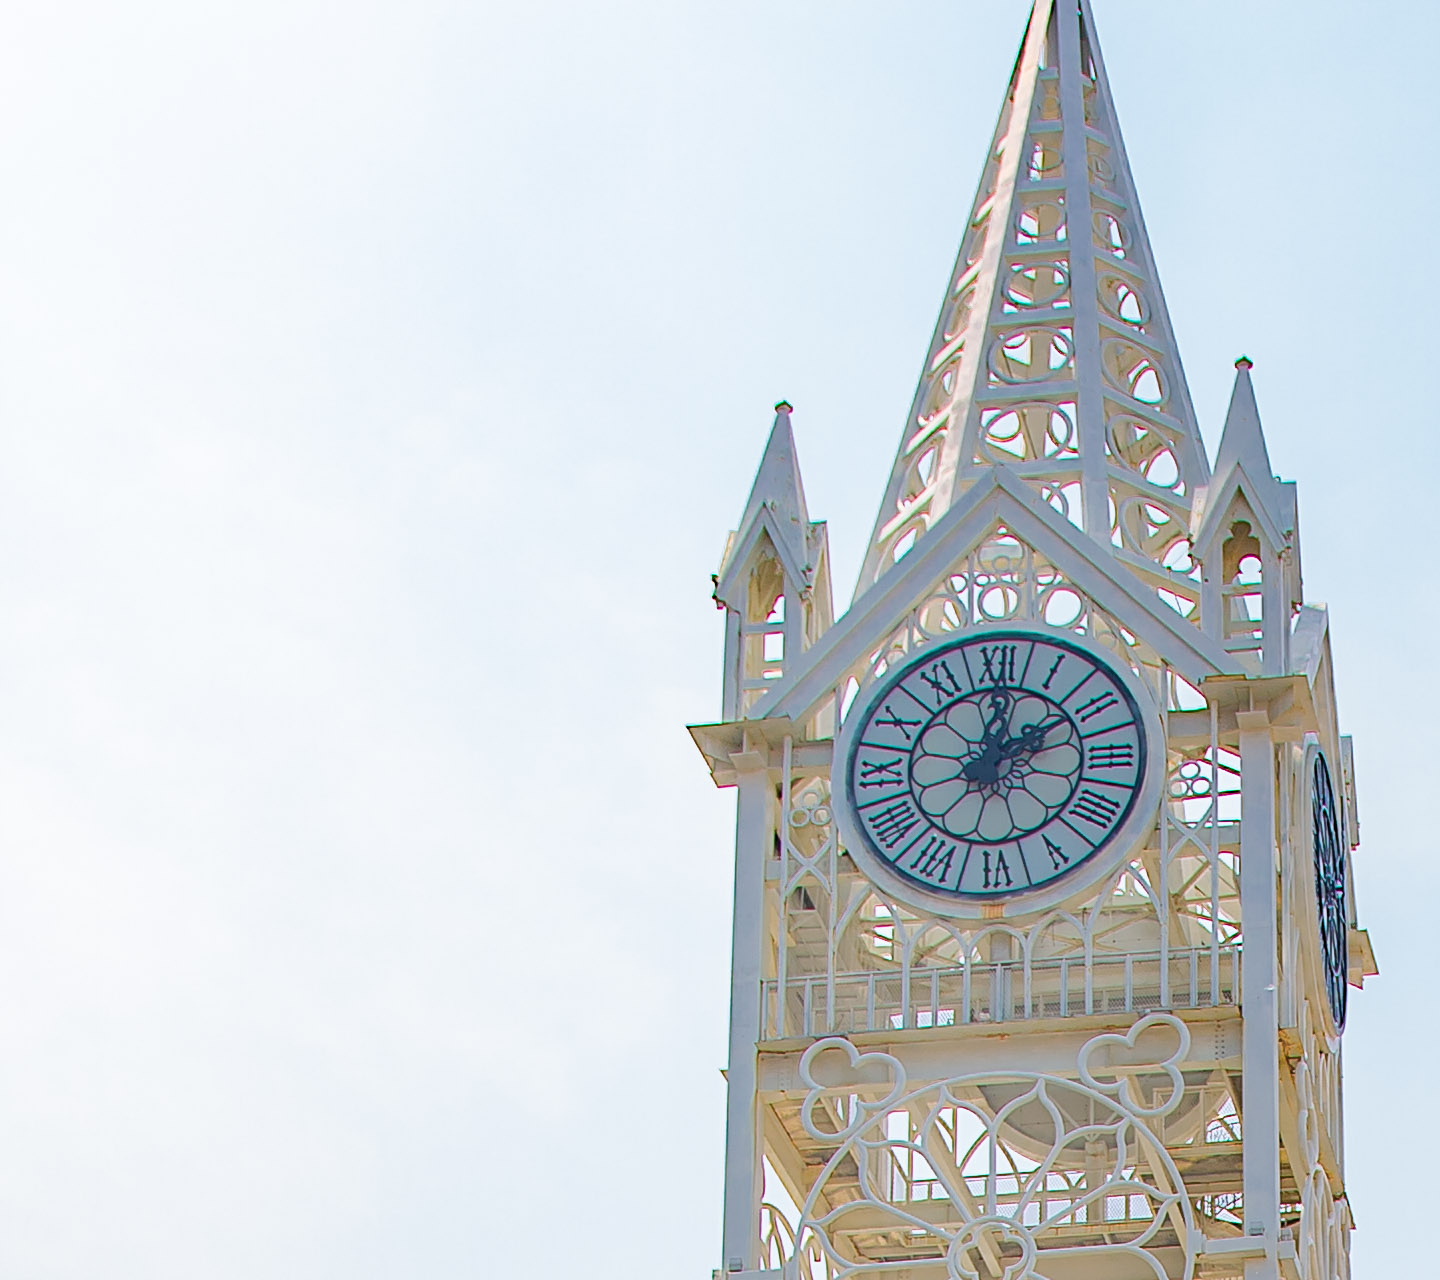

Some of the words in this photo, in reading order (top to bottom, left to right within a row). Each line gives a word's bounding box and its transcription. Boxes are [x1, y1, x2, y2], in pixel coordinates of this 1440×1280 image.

[920, 660, 963, 705] XI
[1042, 653, 1066, 690] I
[875, 705, 922, 741] X
[1075, 690, 1119, 723] II
[1088, 742, 1134, 770] III
[981, 850, 1014, 888] VI
[1042, 834, 1070, 871] V
